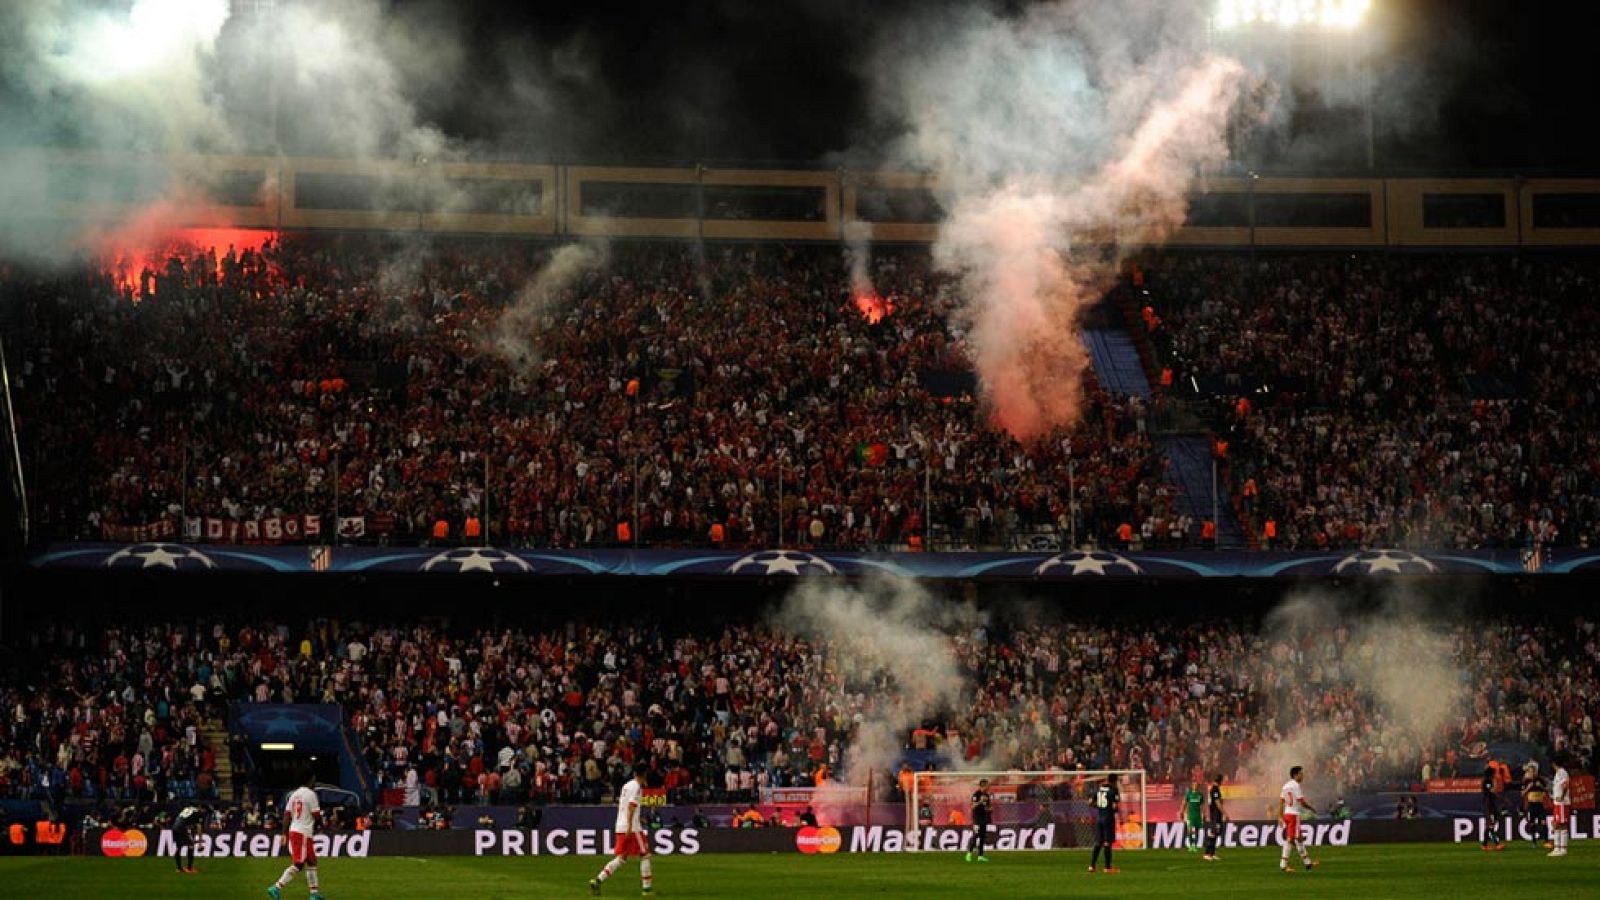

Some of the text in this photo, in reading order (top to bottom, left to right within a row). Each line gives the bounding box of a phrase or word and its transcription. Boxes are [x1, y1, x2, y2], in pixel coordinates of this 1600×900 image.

[207, 515, 320, 541] DIABOS
[156, 829, 371, 857] Masterard
[475, 829, 700, 855] PRICELSS
[1152, 820, 1351, 848] MterCard
